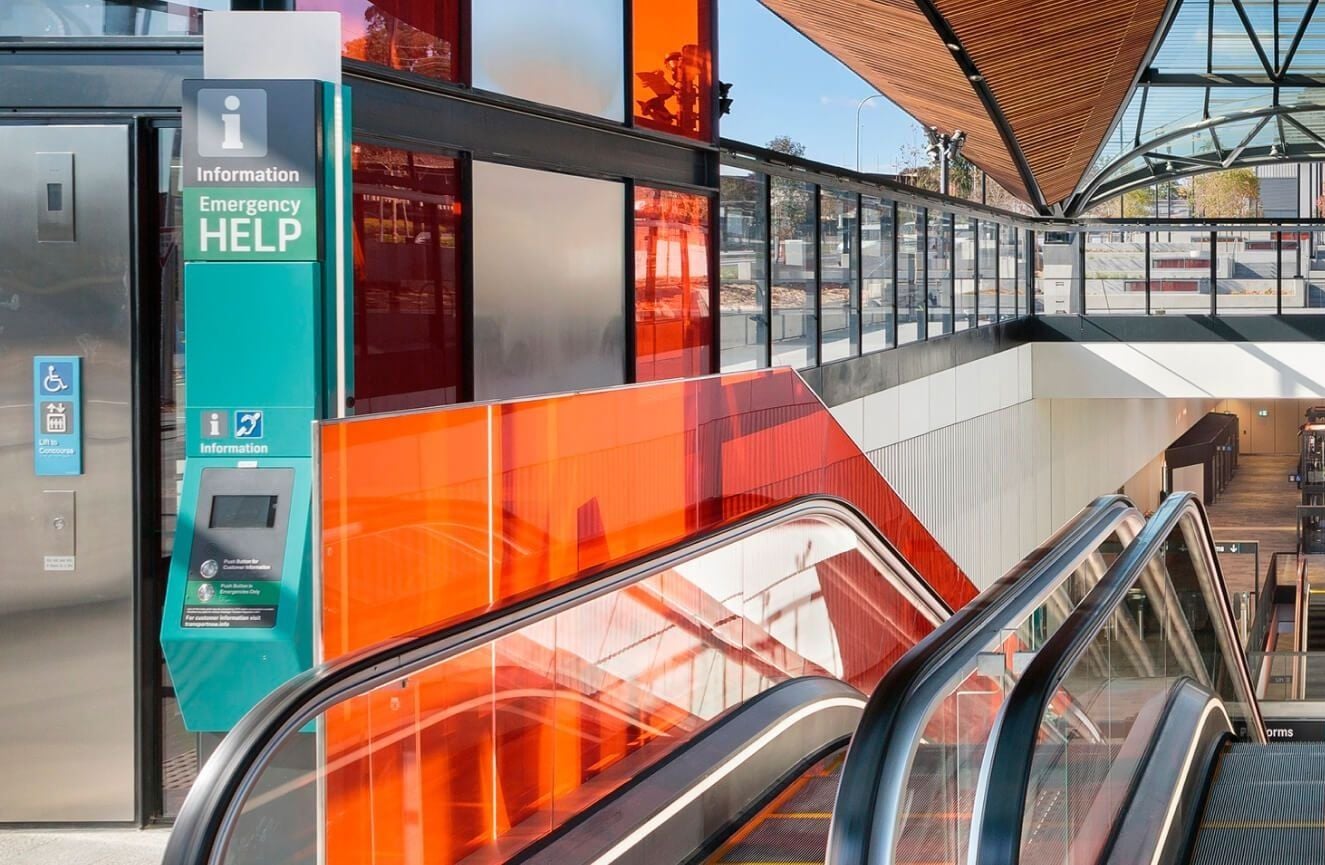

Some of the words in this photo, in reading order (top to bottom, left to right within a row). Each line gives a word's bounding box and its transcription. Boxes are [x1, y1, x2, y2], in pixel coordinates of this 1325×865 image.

[197, 167, 300, 182] Information
[200, 196, 301, 216] Emergency
[200, 218, 302, 252] HELP
[200, 442, 268, 454] Information
